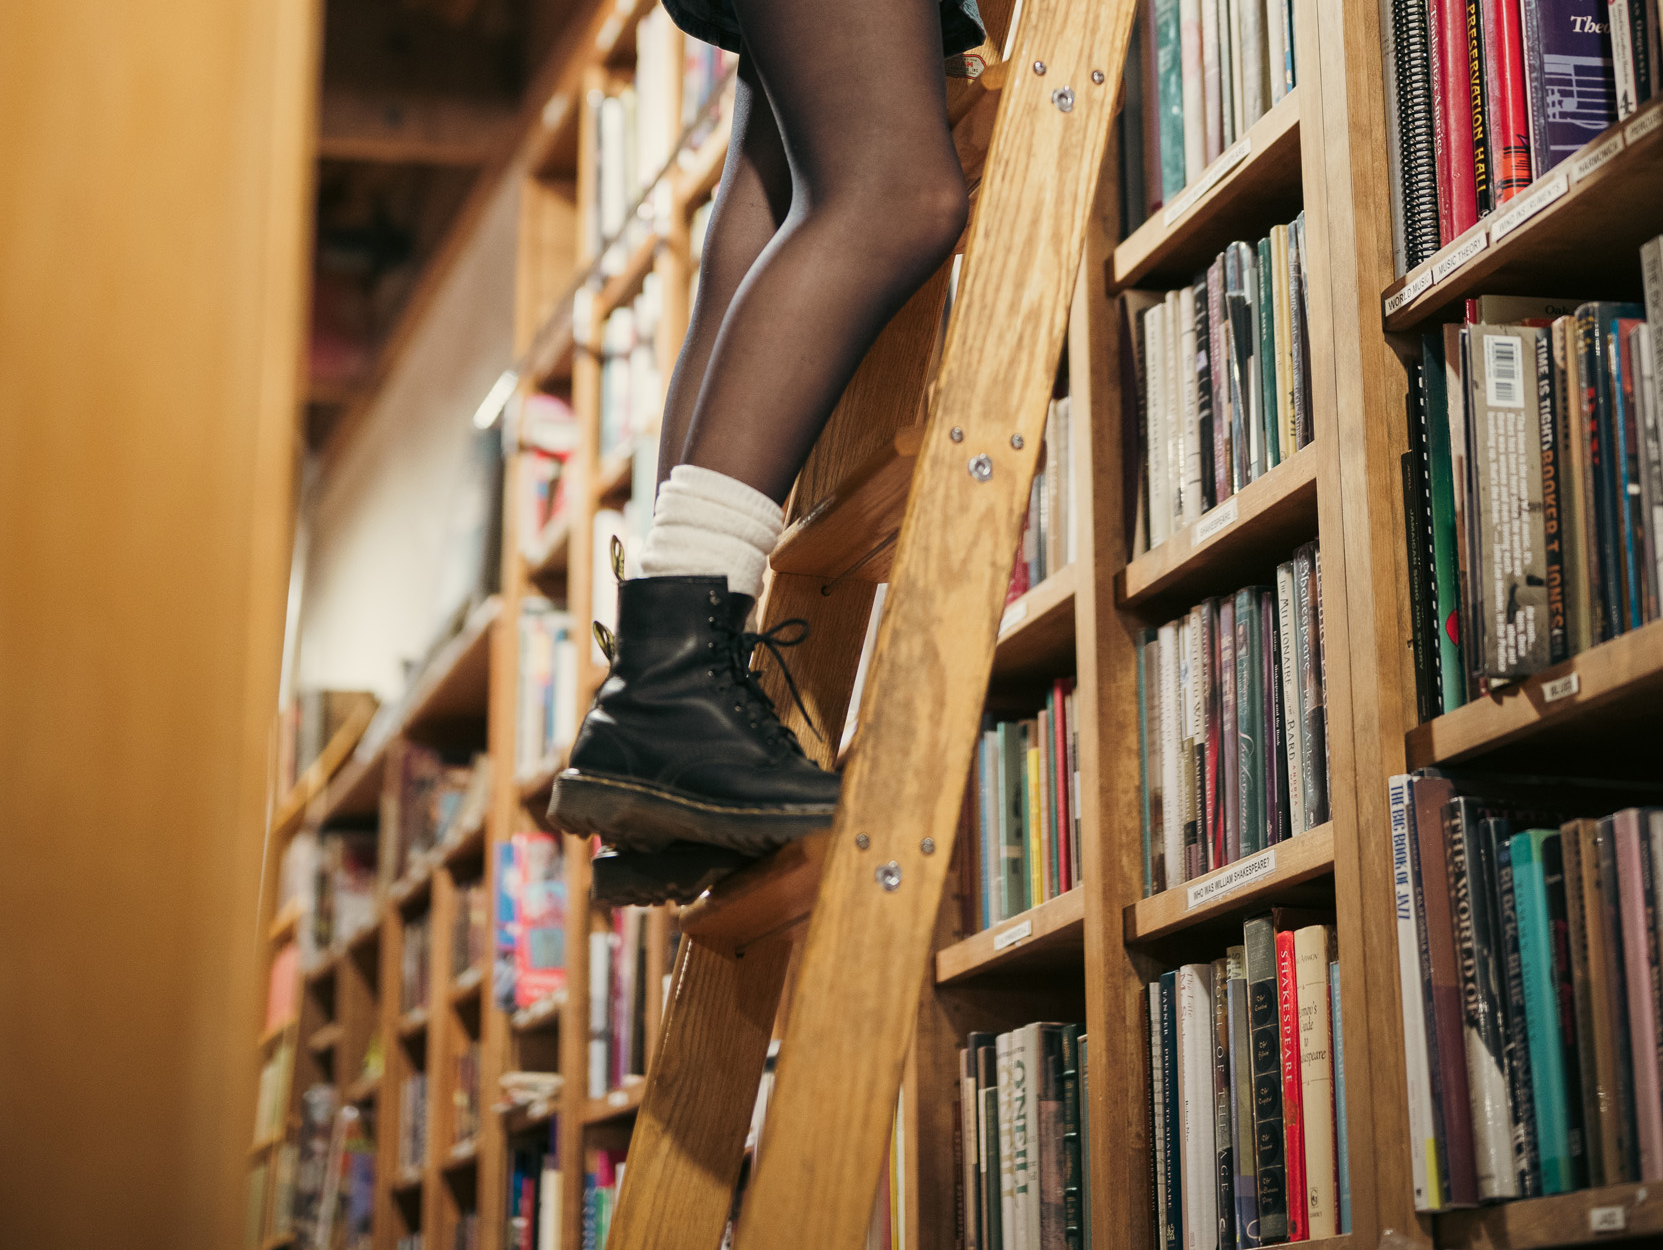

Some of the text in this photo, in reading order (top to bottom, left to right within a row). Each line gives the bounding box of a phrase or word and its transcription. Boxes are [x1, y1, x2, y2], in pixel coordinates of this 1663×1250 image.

[1466, 2, 1484, 141] PRESERVATION
[1433, 94, 1444, 156] America
[1474, 146, 1488, 193] HALL
[1438, 237, 1482, 275] MUSIC THEORY
[1387, 272, 1431, 311] WORLD MUSIC
[1536, 337, 1564, 629] TIME IS TIGHT BOOKER T JONES
[1199, 510, 1232, 537] SHAKESPEARE
[1409, 508, 1419, 565] JAMAICAN
[1279, 579, 1288, 595] THE
[1299, 554, 1311, 671] Shakespeare
[1413, 568, 1421, 601] SONG
[1279, 598, 1292, 688] MILLIONAIRE
[1415, 604, 1423, 628] AND
[1417, 631, 1425, 670] STORY
[1193, 700, 1201, 736] WILL
[1286, 718, 1296, 761] BARD
[1304, 731, 1314, 794] Ackroyd
[1205, 764, 1213, 825] ASQUITH
[1391, 786, 1411, 920] THE BIG BOOK OF JAZZ
[1451, 812, 1466, 872] THE
[1193, 856, 1270, 901] WHO WAS WILLIAM SHAKESPEARE?
[1186, 972, 1194, 1018] The Late
[1280, 950, 1293, 1084] SHAKESPEARE
[1334, 981, 1344, 1081] SHAKESPEARE
[1215, 972, 1229, 1192] SOUL OF THE AGE
[1012, 1059, 1028, 1195] O'NEILL
[1165, 1107, 1171, 1123] TO
[1165, 1126, 1173, 1209] SHAKESPEARE
